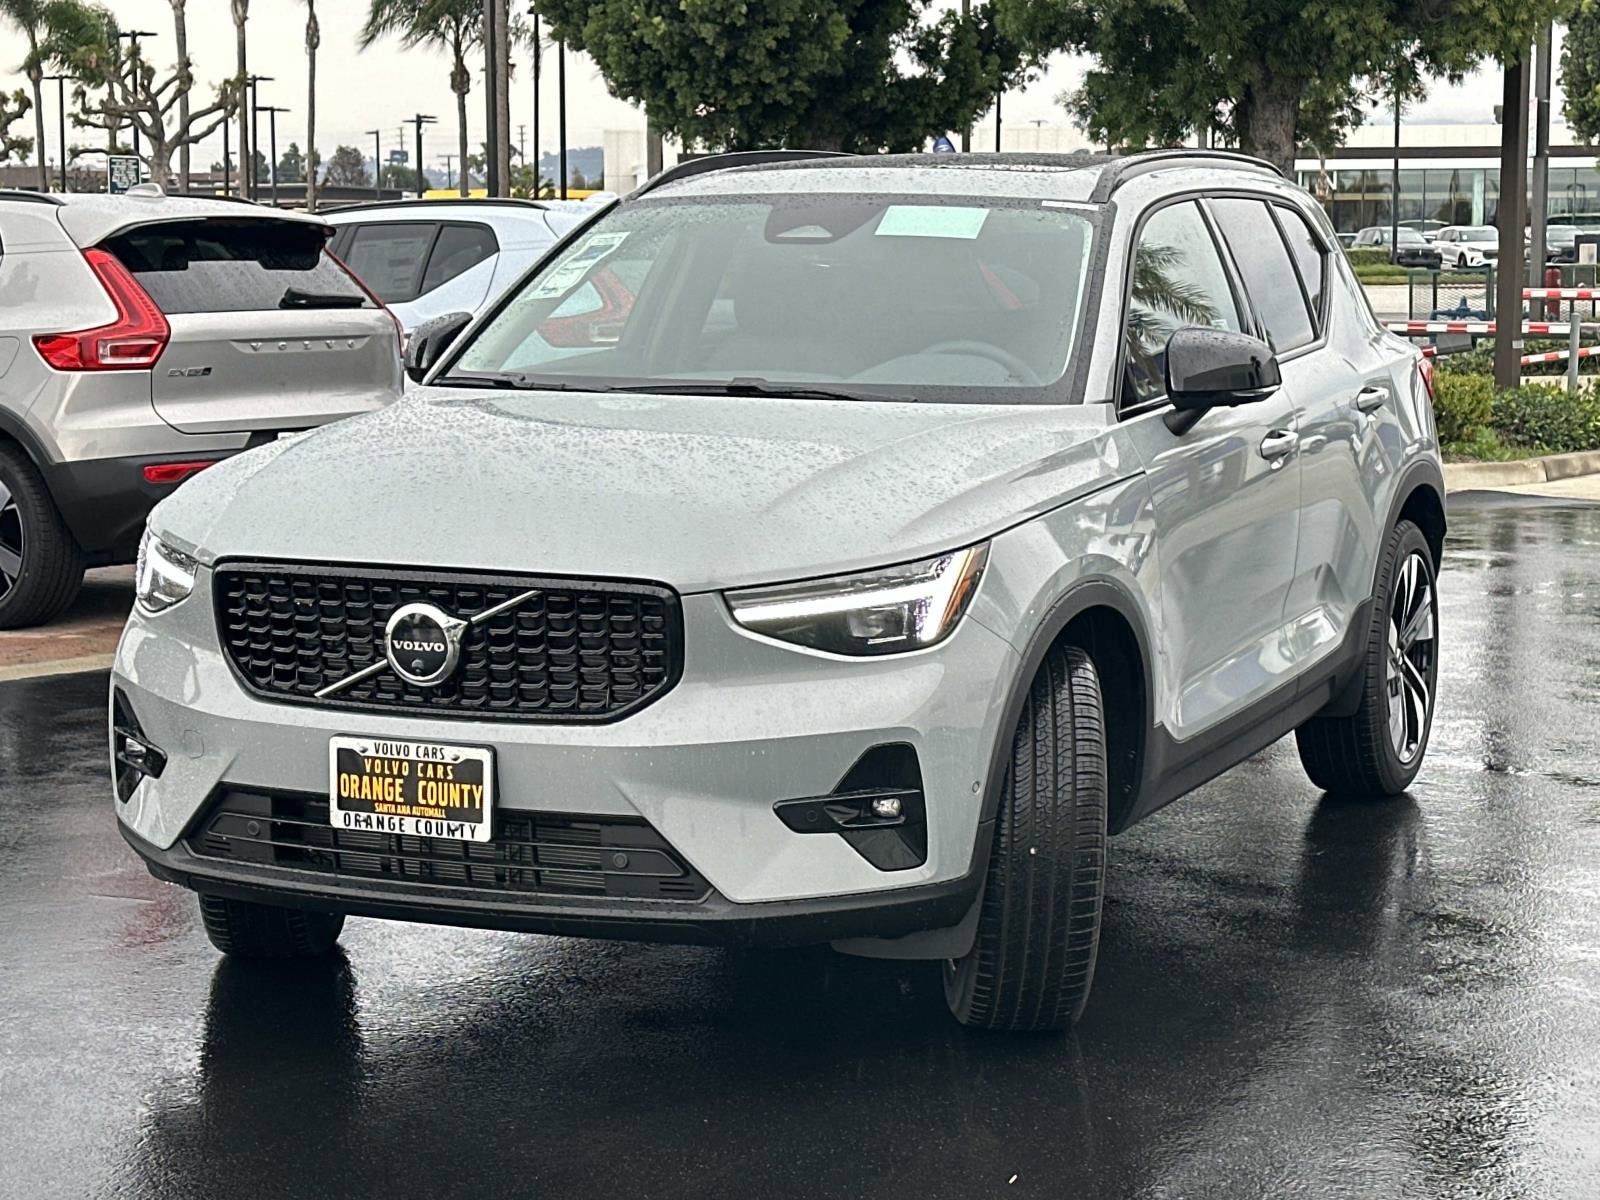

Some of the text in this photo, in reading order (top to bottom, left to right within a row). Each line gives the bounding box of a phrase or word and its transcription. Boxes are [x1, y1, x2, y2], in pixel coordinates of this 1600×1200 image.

[250, 339, 356, 351] VOLVO
[392, 640, 445, 652] VOLVO
[374, 742, 445, 760] VOLVO CARS
[364, 758, 453, 780] VOLVO CARS
[340, 773, 484, 810] ORANGE COUNTY
[374, 802, 447, 819] SANTA ANA AUTOMALL
[343, 812, 477, 839] ORANGE COUNTY
